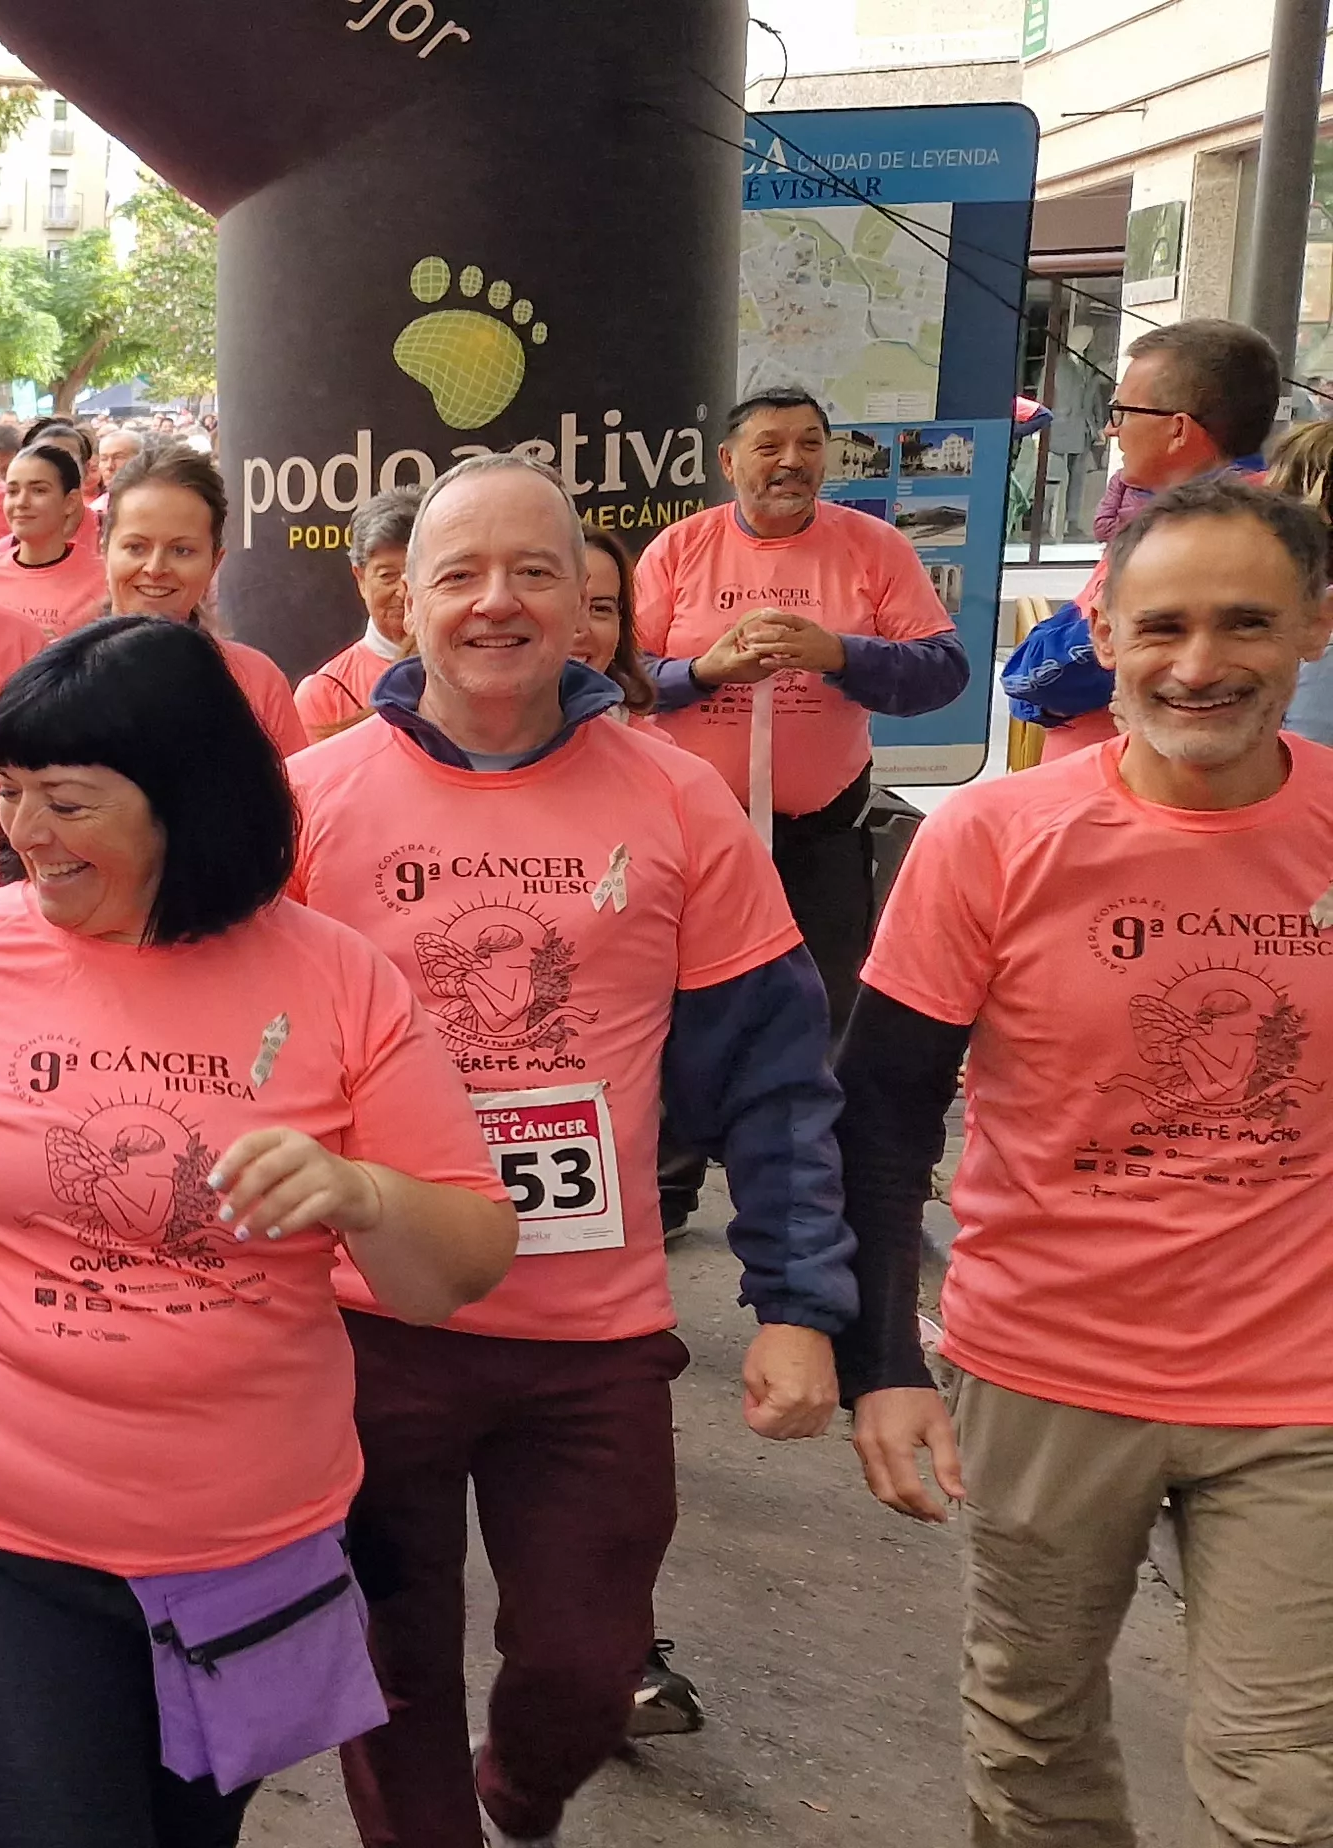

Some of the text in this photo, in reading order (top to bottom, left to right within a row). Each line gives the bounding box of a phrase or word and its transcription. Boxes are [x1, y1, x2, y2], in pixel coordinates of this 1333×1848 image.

[345, 0, 471, 59] jor
[797, 152, 872, 172] CIUDAD
[879, 151, 905, 170] DE
[910, 148, 1001, 169] LEYENDA
[770, 176, 883, 200] VISITAR
[746, 586, 811, 599] CÁNCER
[374, 844, 443, 916] CARRERA CONTRA EL
[396, 852, 587, 902] 9ª CÁNCER
[1112, 907, 1321, 960] 9ª CÁNCER
[30, 1045, 231, 1093] 9ª CÁNCER
[526, 1054, 587, 1073] MUCHO
[165, 1077, 257, 1101] HUESCA
[510, 1119, 588, 1141] CÁNCER
[1130, 1119, 1302, 1145] QUIÉRETE MUCHO
